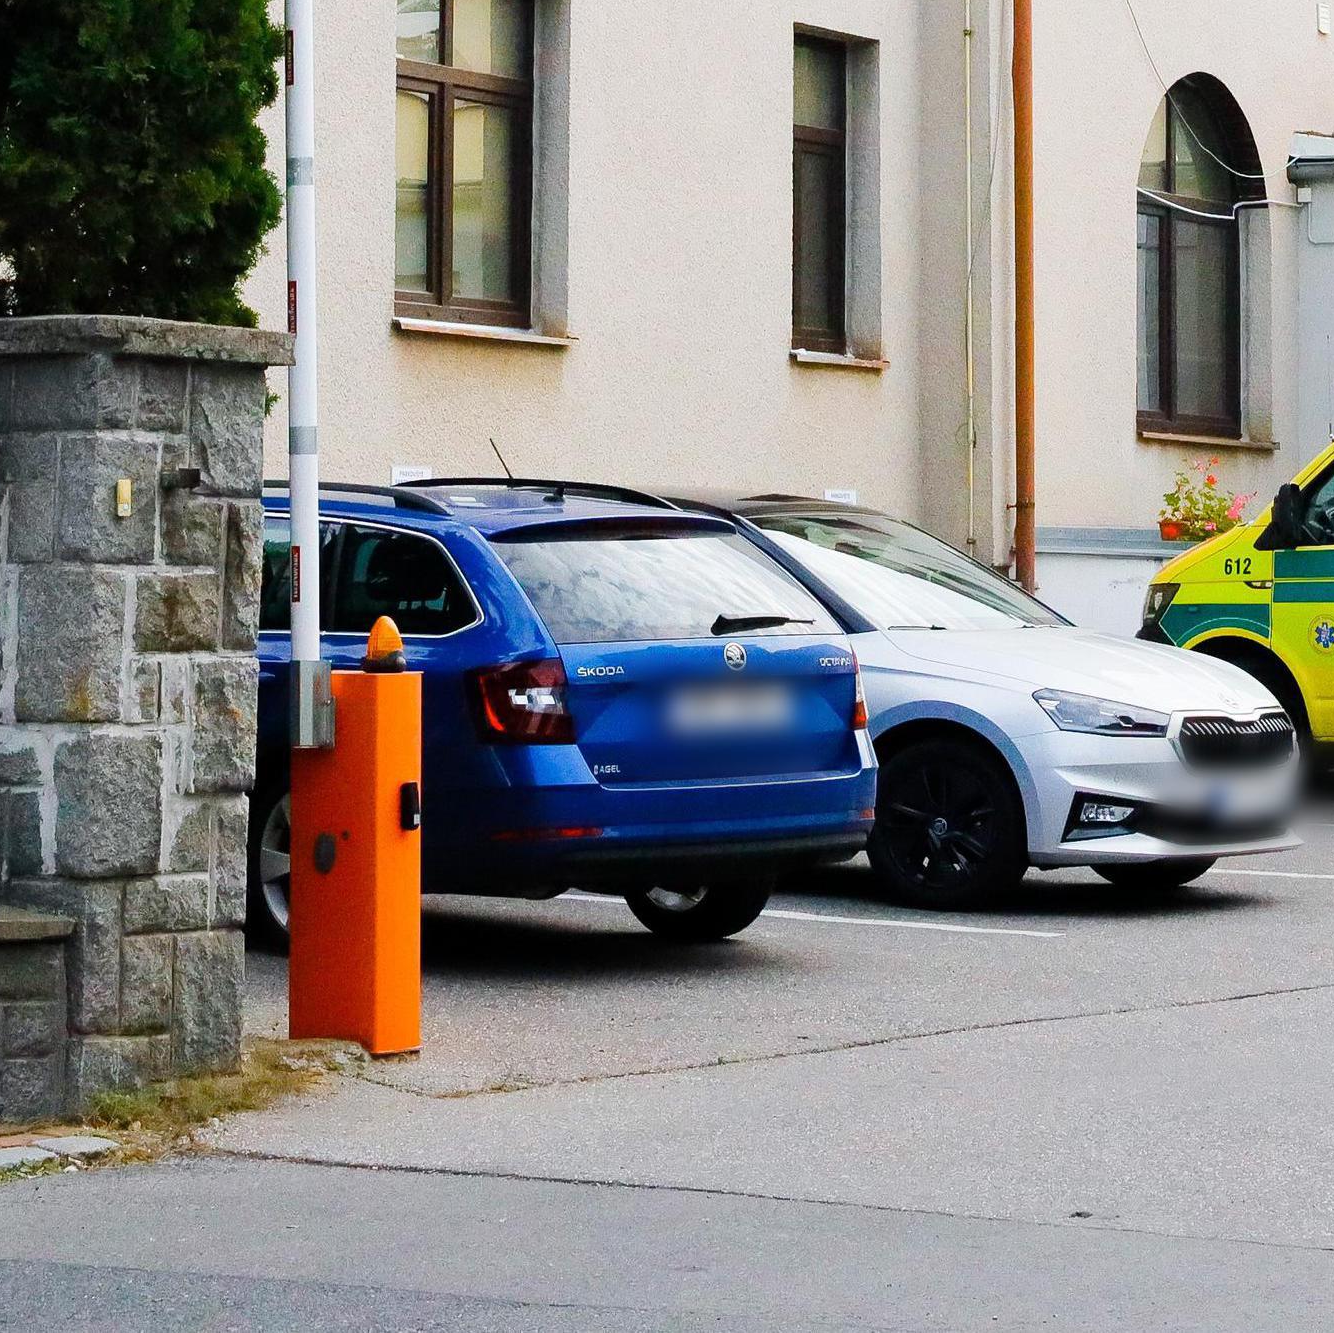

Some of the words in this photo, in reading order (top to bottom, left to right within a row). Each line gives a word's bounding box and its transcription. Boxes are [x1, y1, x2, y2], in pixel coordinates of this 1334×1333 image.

[1224, 557, 1252, 575] 612
[577, 665, 625, 677] ŠKODA
[599, 765, 621, 774] AGEL
